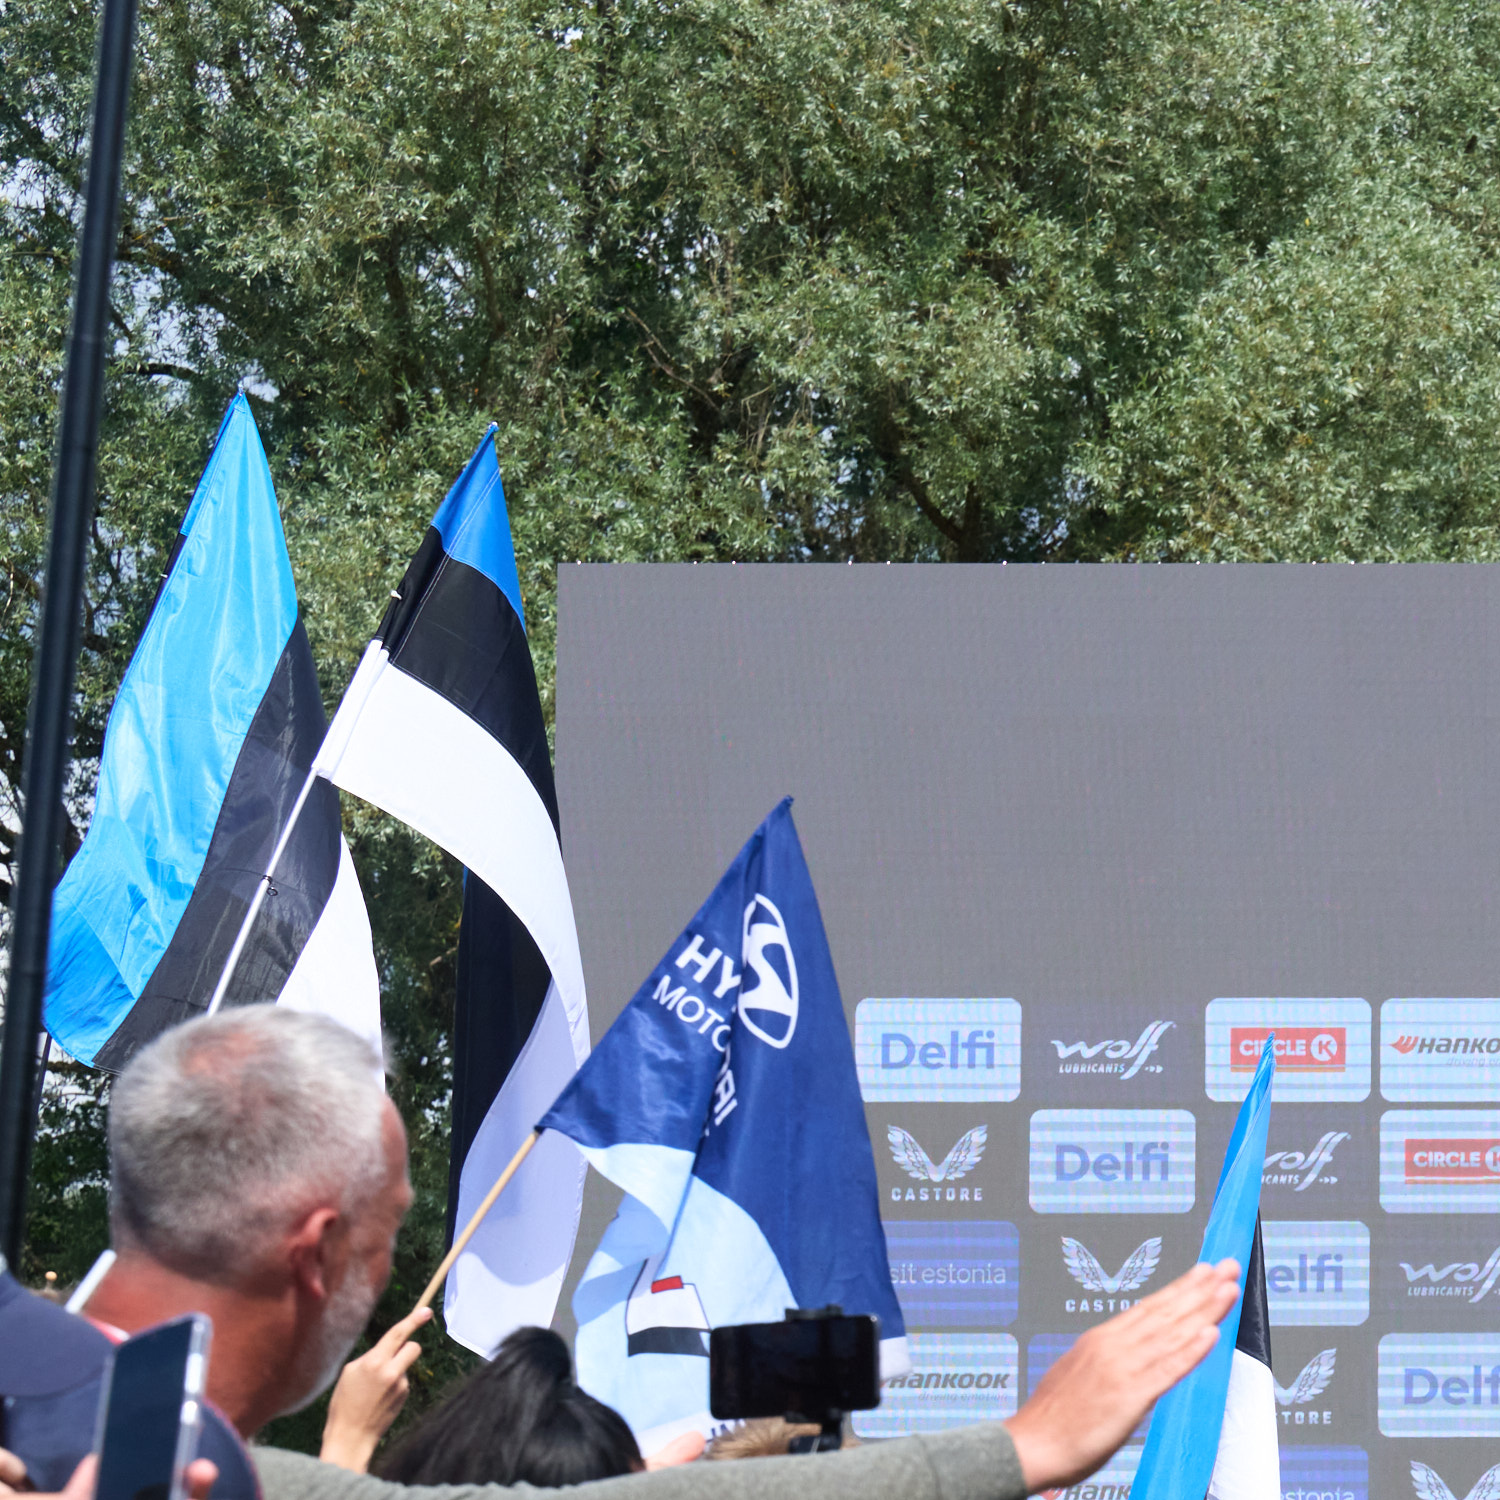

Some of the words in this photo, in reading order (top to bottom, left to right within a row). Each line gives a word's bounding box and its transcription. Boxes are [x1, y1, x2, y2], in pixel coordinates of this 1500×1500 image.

[881, 1030, 995, 1070] Delfi
[1060, 1064, 1127, 1074] LUBRICANTS
[1055, 1141, 1169, 1181] Delfi
[1414, 1152, 1481, 1169] CIRCLE
[890, 1186, 983, 1201] CASTORE
[919, 1262, 1004, 1284] estonia
[1409, 1287, 1476, 1297] LUBRICANTS
